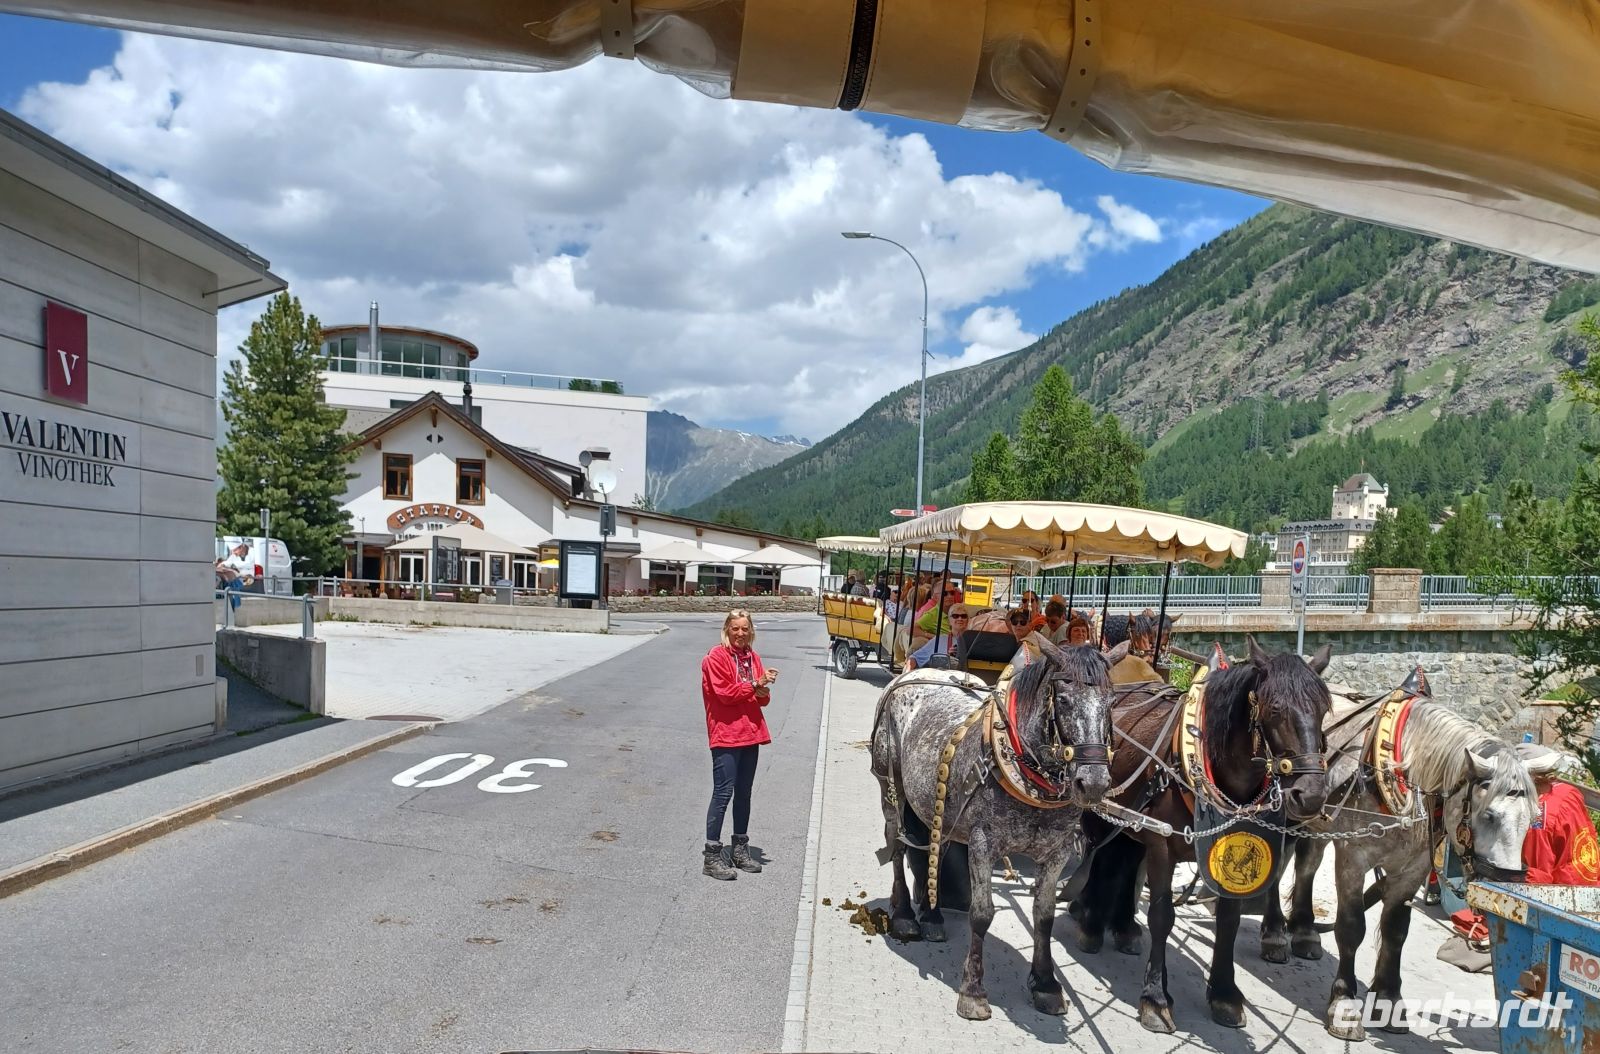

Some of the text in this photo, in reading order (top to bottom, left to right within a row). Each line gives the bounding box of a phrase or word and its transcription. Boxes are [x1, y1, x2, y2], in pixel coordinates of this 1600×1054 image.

[57, 349, 80, 385] V
[1, 411, 127, 462] VALENTIN
[17, 452, 116, 487] VINOTHEK
[396, 505, 475, 524] STATION
[391, 752, 569, 794] 30
